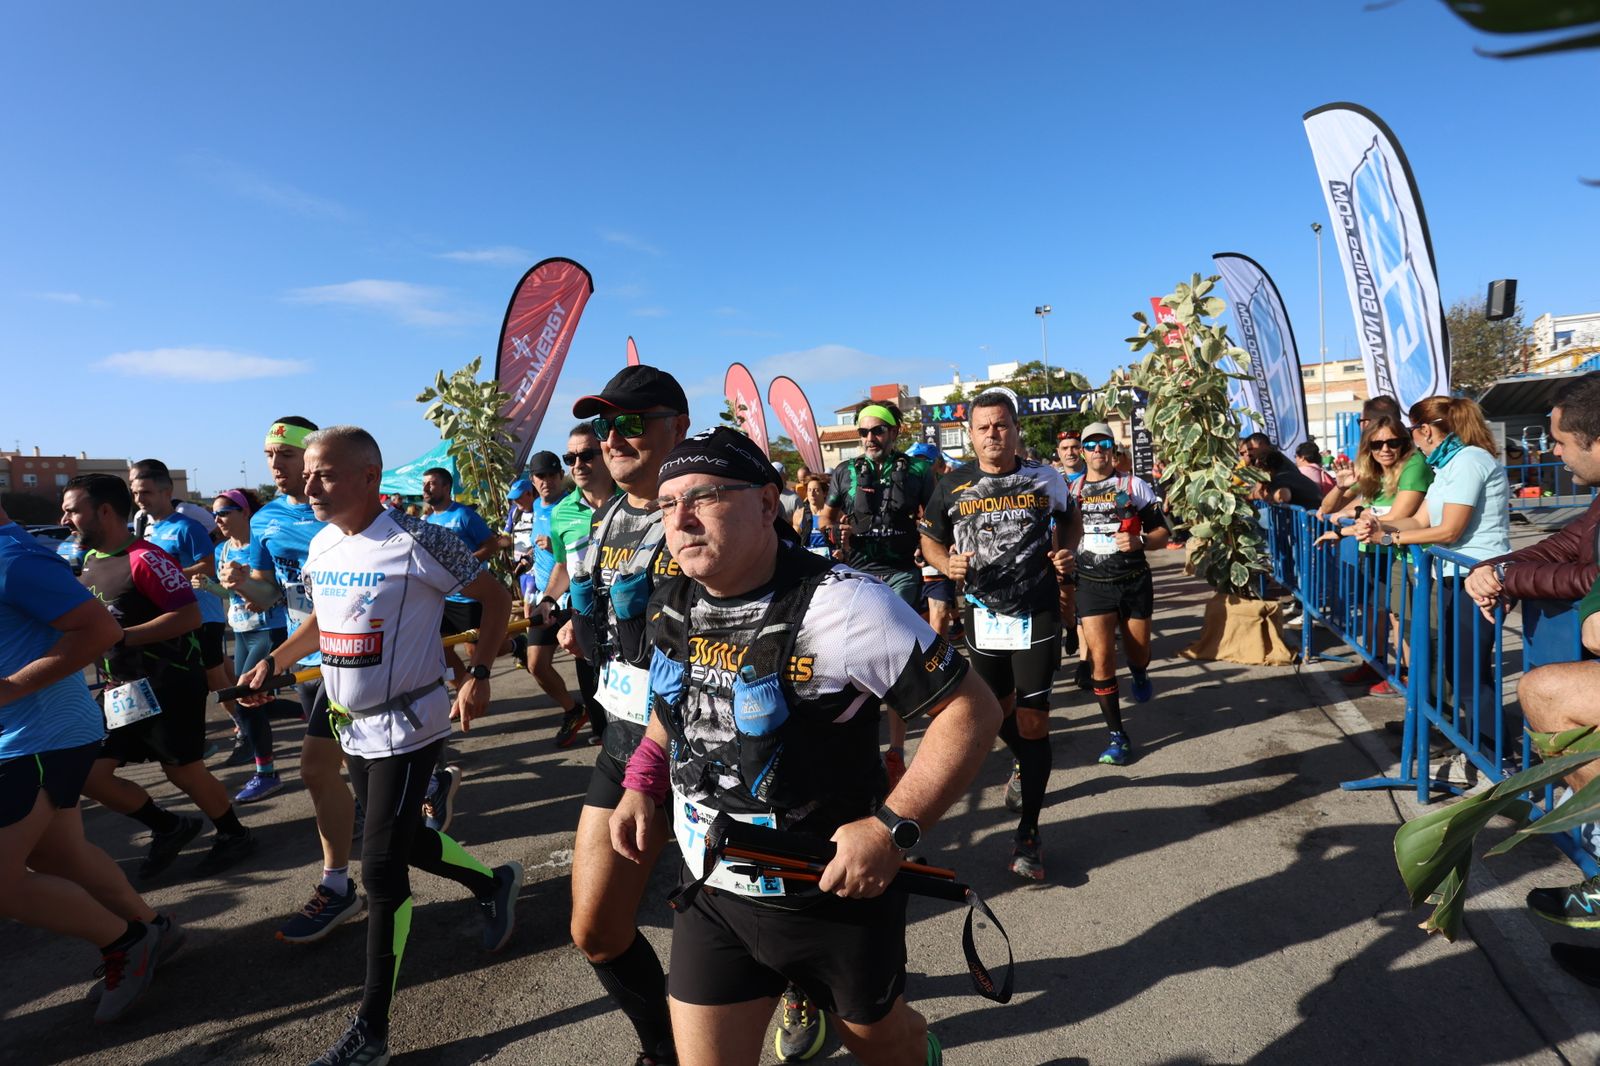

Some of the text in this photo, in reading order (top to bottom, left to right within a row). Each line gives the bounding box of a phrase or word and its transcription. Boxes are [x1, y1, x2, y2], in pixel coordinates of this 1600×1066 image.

[514, 301, 566, 404] TEAMERGY
[1029, 395, 1077, 412] TRAIL
[982, 508, 1027, 522] TEAM
[1081, 503, 1113, 511] TEAM
[311, 571, 385, 588] RUNCHIP
[321, 587, 347, 597] JEREZ
[112, 697, 137, 714] 512
